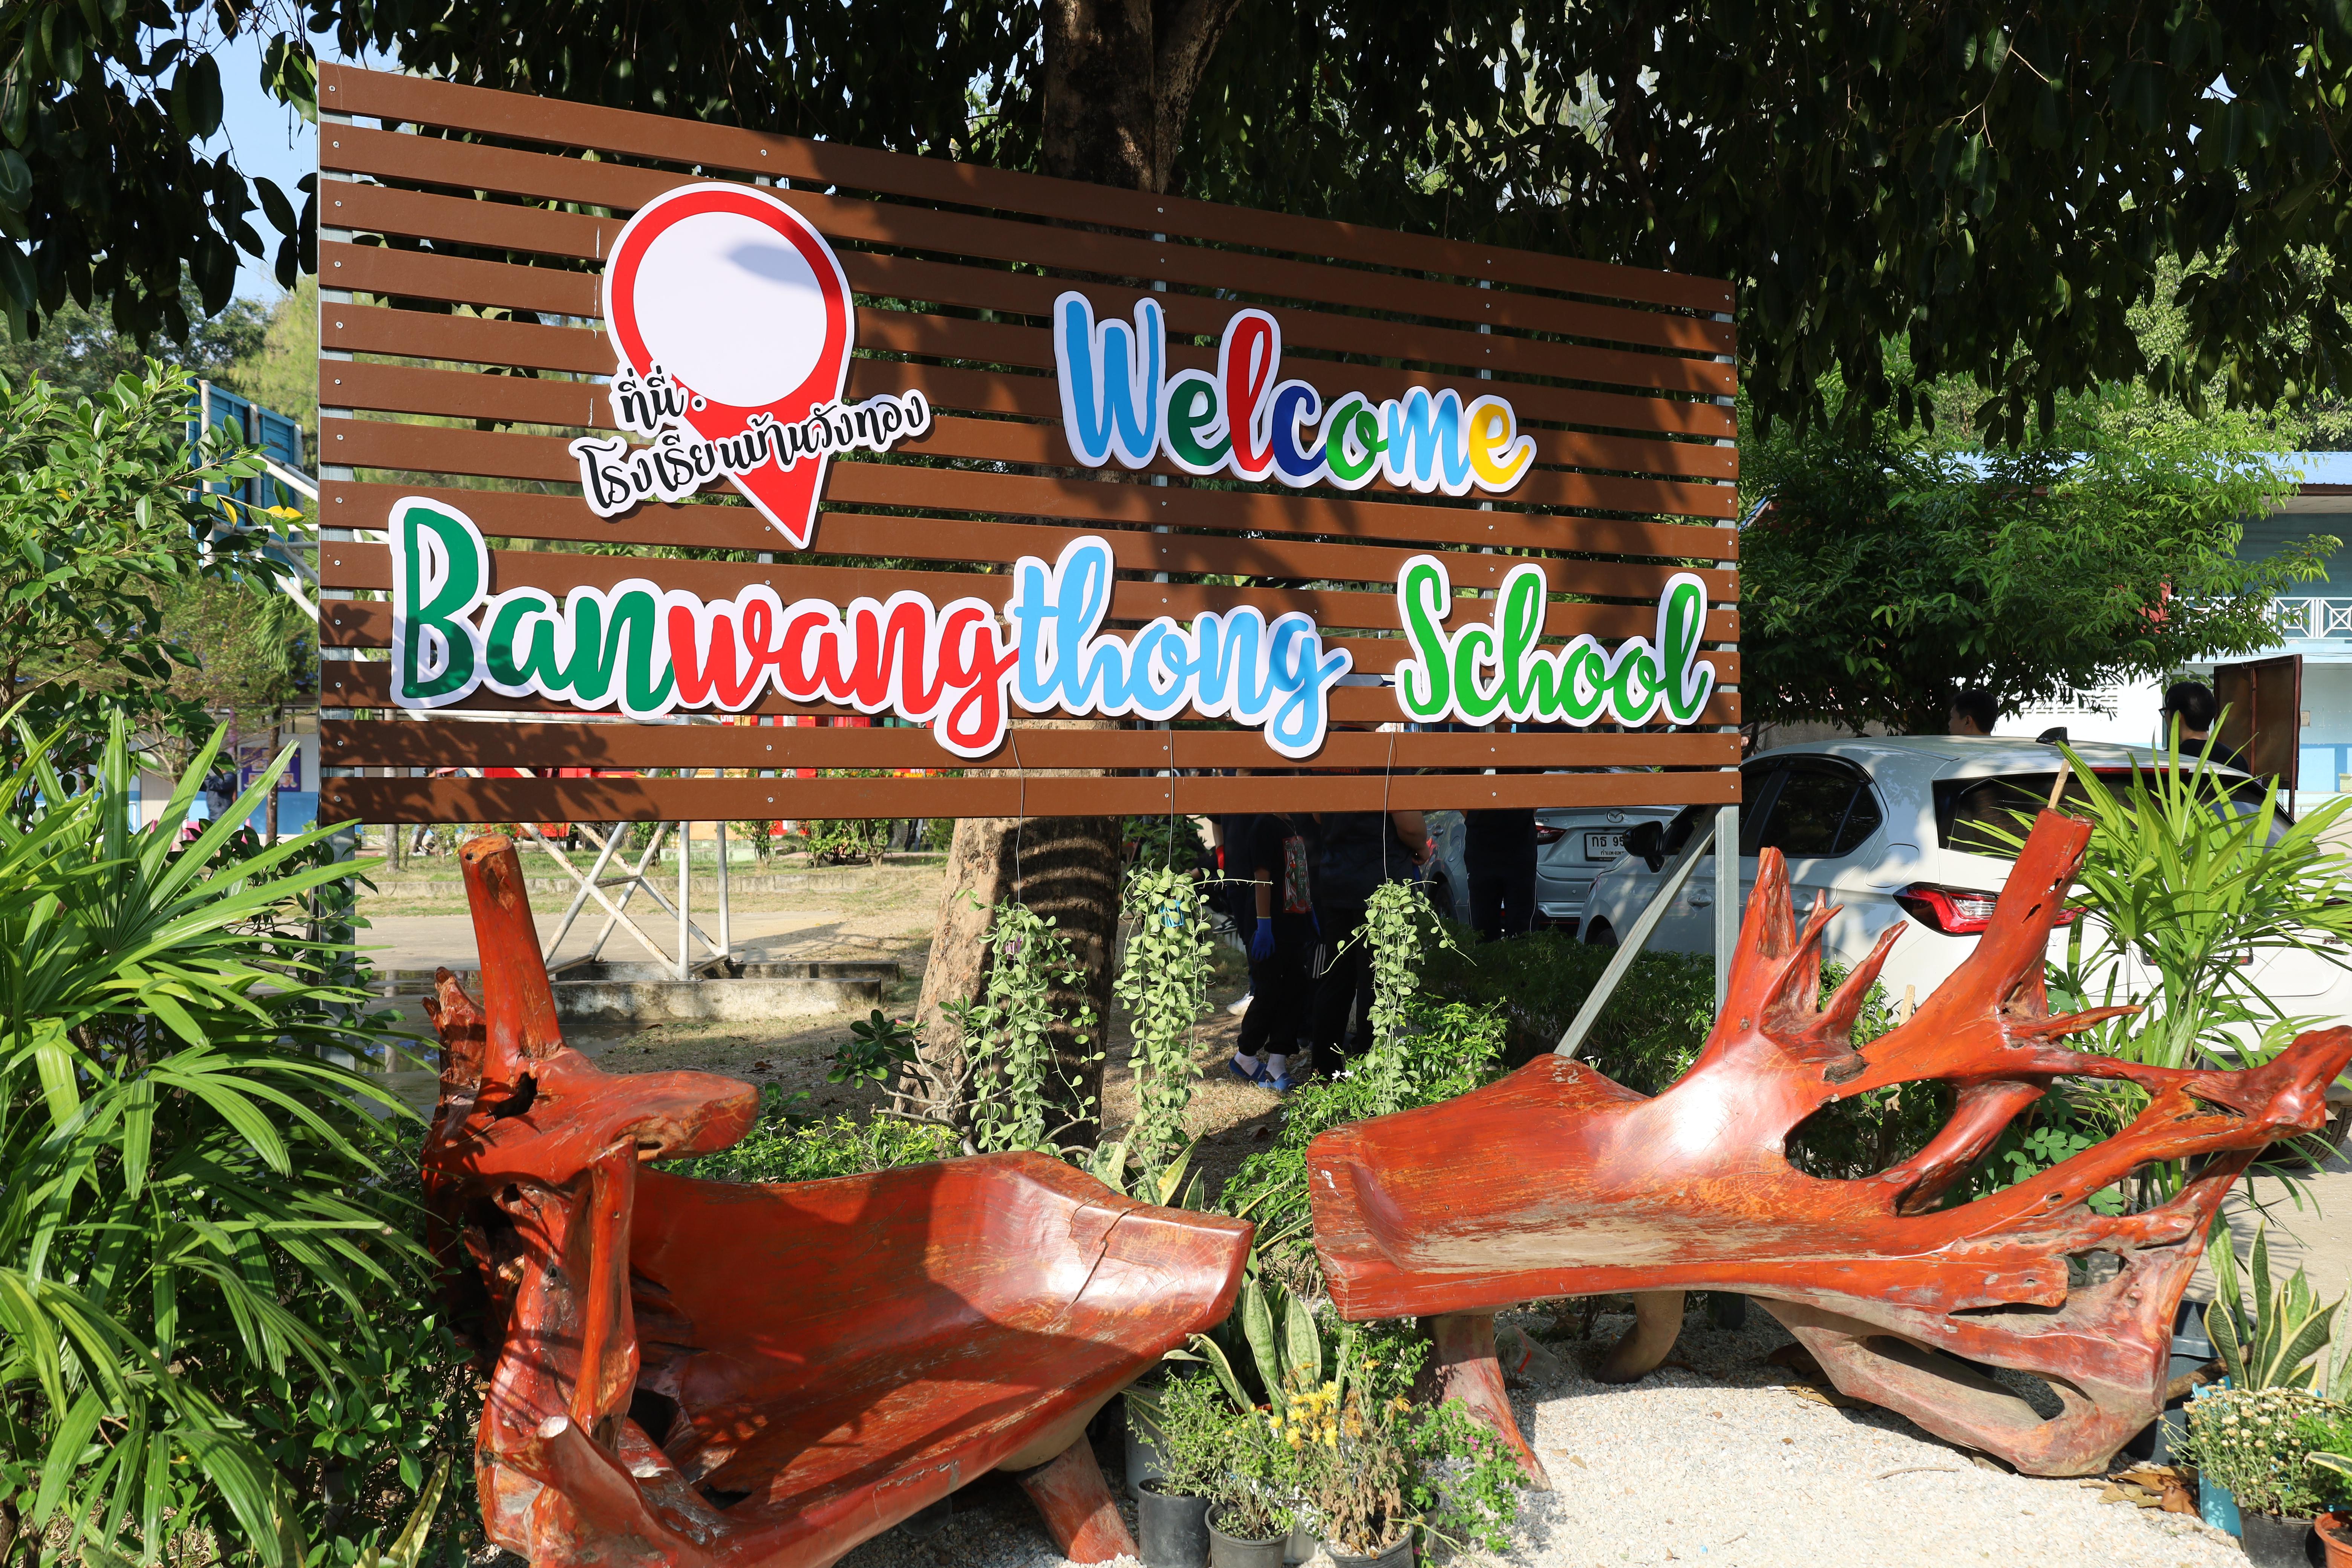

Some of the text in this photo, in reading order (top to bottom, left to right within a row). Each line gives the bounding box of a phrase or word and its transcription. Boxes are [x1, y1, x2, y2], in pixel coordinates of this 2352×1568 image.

[576, 391, 923, 508] โรงเรียนบ้านวังทอง
[1066, 300, 1531, 486] Welcome
[402, 507, 1709, 749] Banwangthong School
[1591, 836, 1624, 847] กธ 95
